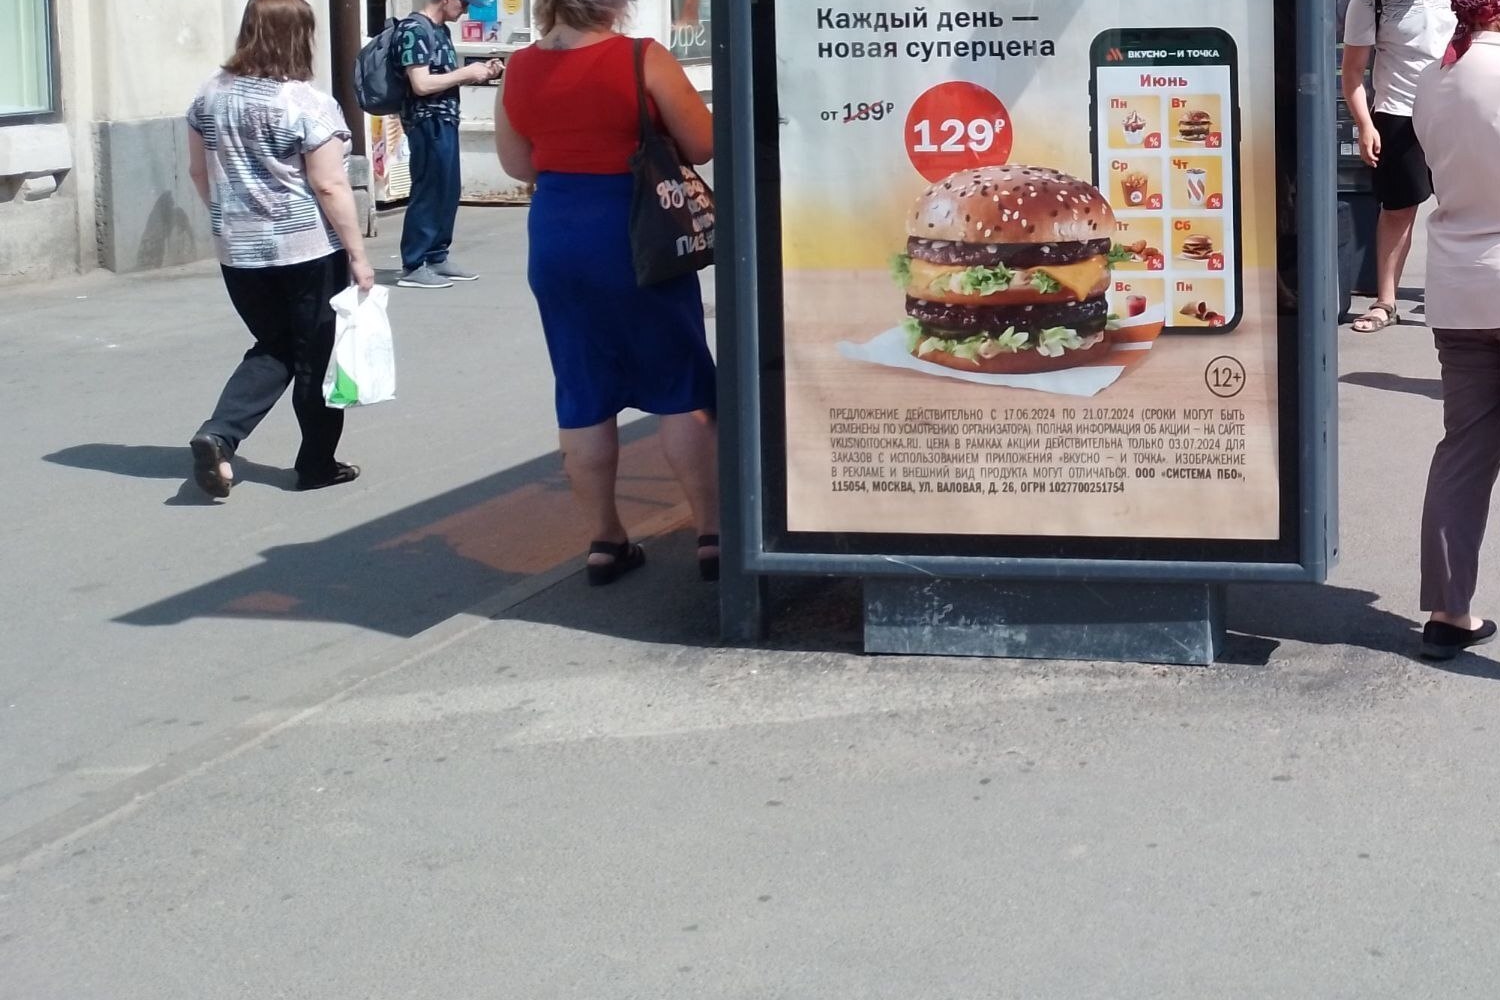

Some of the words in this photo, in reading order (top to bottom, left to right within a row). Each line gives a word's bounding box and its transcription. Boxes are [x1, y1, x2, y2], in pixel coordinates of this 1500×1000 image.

[817, 6, 928, 32] Каждый
[937, 10, 1004, 31] день
[818, 41, 898, 58] новая
[906, 38, 1056, 62] суперцена
[1127, 50, 1167, 59] ВКУСНО
[1177, 49, 1185, 58] И
[1187, 49, 1220, 58] ТОЧКА
[1140, 74, 1188, 87] Июнь
[1110, 98, 1127, 109] Пн
[1171, 98, 1188, 108] Вт
[820, 111, 838, 121] от
[1111, 160, 1128, 172] Ср
[1173, 159, 1189, 169] Чт
[1174, 220, 1191, 231] Сб
[1115, 282, 1131, 292] Вс
[1176, 281, 1193, 292] Пн
[1212, 367, 1241, 388] 12+
[829, 408, 898, 421] ПРЕДЛОЖЕНИЕ
[904, 406, 983, 421] ДЕЙСТВИТЕЛЬНО
[990, 408, 996, 421] С
[1062, 408, 1076, 421] ПО
[1082, 408, 1134, 421] 21.07.2024
[1142, 408, 1176, 421] (СРОКИ
[1183, 409, 1214, 421] МОГУТ
[1220, 409, 1245, 421] БЫТЬ
[830, 423, 880, 435] ИЗМЕНЕНЫ
[883, 423, 896, 435] ПО
[899, 423, 959, 435] УСМОТРЕНИЮ
[1036, 423, 1072, 435] ПОЛНАЯ
[1076, 424, 1140, 435] ИНФОРМАЦИЯ
[1144, 424, 1156, 435] ОБ
[1158, 424, 1190, 435] АКЦИИ
[1203, 424, 1216, 435] НА
[1218, 424, 1246, 435] САЙТЕ
[926, 438, 950, 449] ЦЕНА
[954, 438, 961, 449] В
[966, 438, 1002, 449] РАМКАХ
[1007, 438, 1040, 449] АКЦИИ
[1044, 436, 1122, 450] ДЕЙСТВИТЕЛЬНА
[1128, 438, 1164, 449] ТОЛЬКО
[1168, 438, 1220, 450] 03.07.2024
[1225, 438, 1245, 450] ДЛЯ
[831, 452, 872, 464] ЗАКАЗОВ
[878, 452, 884, 464] С
[890, 453, 979, 464] ИСПОЛЬЗОВАНИЕМ
[985, 453, 1052, 464] ПРИЛОЖЕНИЯ
[1058, 453, 1100, 464] «ВКУСНО
[1120, 453, 1127, 464] И
[1175, 453, 1246, 464] ИЗОБРАЖЕНИЕ
[832, 467, 838, 478] В
[842, 467, 885, 478] РЕКЛАМЕ
[890, 467, 897, 478] И
[902, 467, 950, 478] ВНЕШНИЙ
[956, 467, 975, 478] ВИД
[980, 467, 1028, 479] ПРОДУКТА
[1032, 467, 1063, 479] МОГУТ
[1068, 467, 1130, 479] ОТЛИЧАТЬСЯ.
[1135, 467, 1156, 479] ООО
[1161, 468, 1212, 479] «СИСТЕМА
[832, 481, 869, 493] 115054,
[872, 481, 916, 493] МОСКВА,
[918, 481, 934, 493] УЛ.
[936, 482, 985, 493] ВАЛОВАЯ,
[1002, 482, 1017, 493] 26,
[1020, 482, 1046, 493] ОГРН
[1050, 482, 1124, 493] 1027700251754
